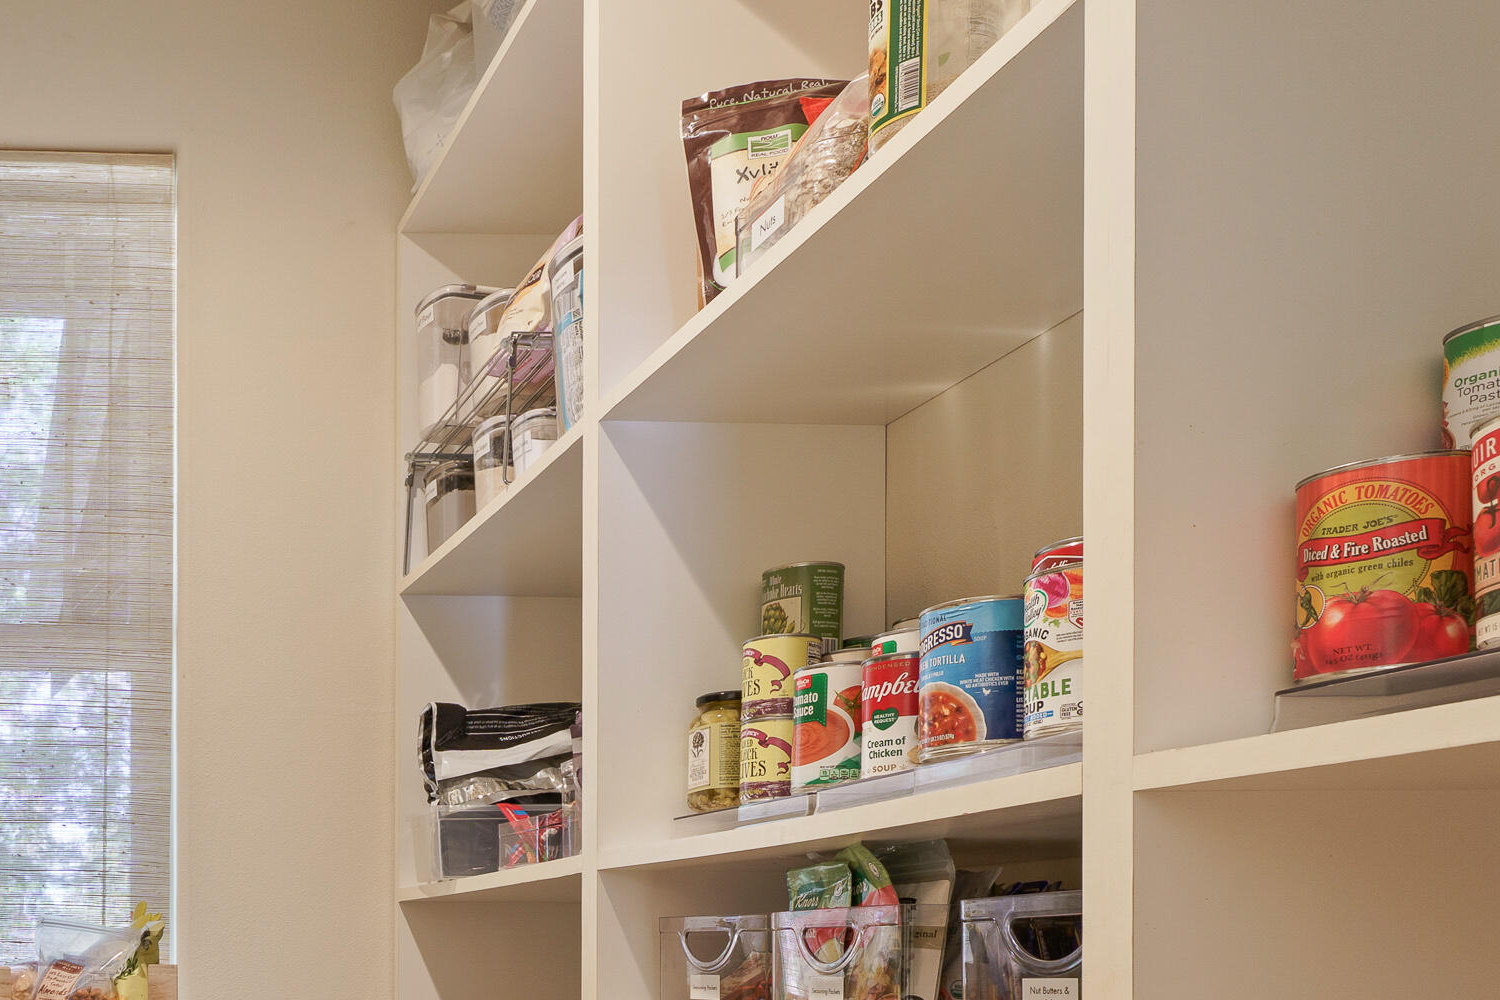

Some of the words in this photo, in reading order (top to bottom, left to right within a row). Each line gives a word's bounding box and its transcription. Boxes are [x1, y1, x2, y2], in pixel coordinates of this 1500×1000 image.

[708, 98, 739, 109] Pure.
[743, 83, 797, 102] Natural.
[801, 79, 829, 91] Real.
[759, 215, 776, 236] Nuts
[1301, 490, 1348, 538] ORGANIC
[1355, 484, 1435, 515] TOMATOES
[1321, 523, 1359, 535] TRADER
[1363, 515, 1394, 530] JOE'S
[1303, 545, 1328, 563] Diced
[1330, 543, 1341, 559] &
[1343, 541, 1370, 558] Fire
[1371, 525, 1429, 552] Roasted
[1311, 573, 1325, 582] with
[1326, 566, 1355, 579] organic
[1358, 562, 1383, 573] green
[1386, 557, 1414, 568] chiles
[930, 654, 965, 666] TORTILLA
[868, 740, 894, 749] Cream
[896, 736, 906, 745] of
[869, 748, 903, 759] Chicken
[872, 764, 897, 773] SOUP
[38, 984, 67, 996] Almonds
[1030, 986, 1041, 995] Nut
[1042, 986, 1062, 995] Butters
[1064, 986, 1070, 995] &
